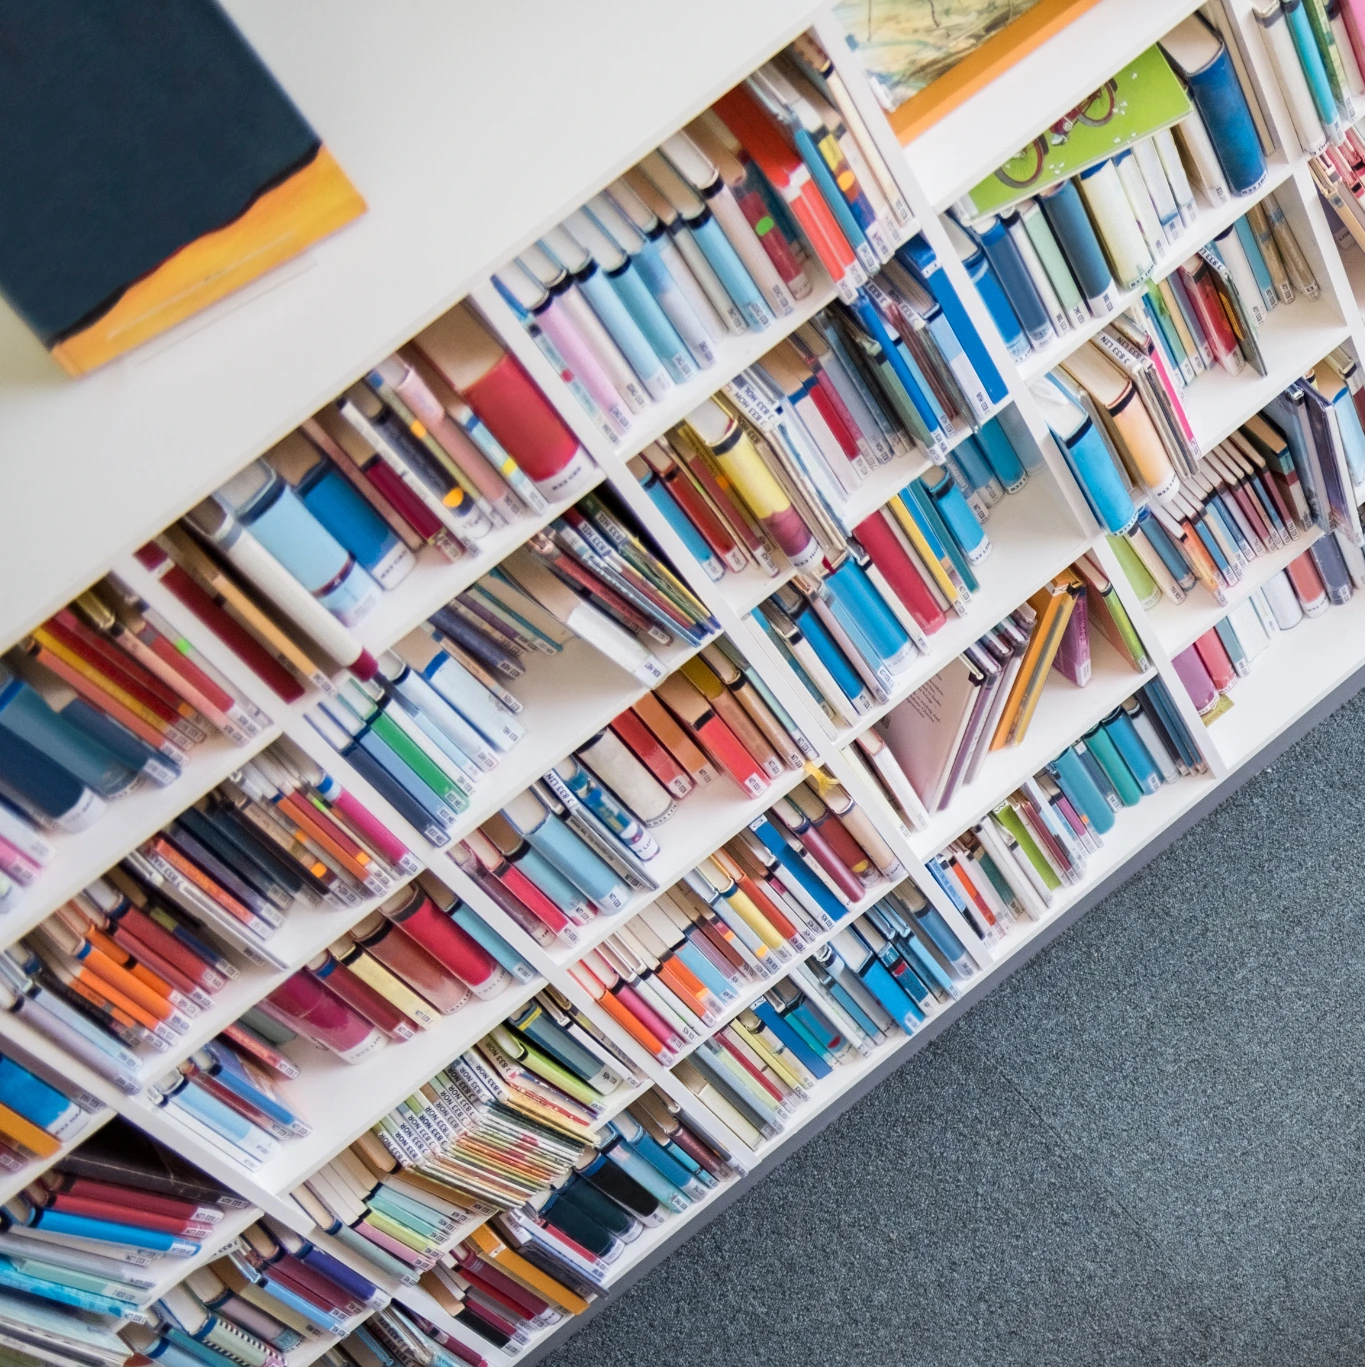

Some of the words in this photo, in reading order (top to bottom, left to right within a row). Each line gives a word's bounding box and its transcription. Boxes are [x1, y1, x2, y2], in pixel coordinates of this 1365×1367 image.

[886, 288, 904, 306] HUB
[900, 302, 916, 318] 833
[1100, 334, 1114, 348] LIN
[1116, 334, 1130, 349] LIN
[1110, 345, 1126, 360] 833
[1126, 345, 1142, 361] 833
[732, 390, 751, 409] HOH
[742, 385, 759, 403] HOL
[747, 406, 762, 422] 833
[755, 400, 770, 416] 833
[595, 512, 611, 528] HIL
[579, 522, 594, 538] HIL
[607, 524, 624, 541] 833
[590, 534, 607, 552] 833
[544, 772, 559, 787] LIN
[554, 783, 570, 800] 833
[162, 866, 179, 883] 833
[484, 1040, 499, 1056] NOR
[495, 1054, 508, 1068] 833
[447, 1066, 462, 1083] NOR
[459, 1066, 474, 1083] NOR
[475, 1063, 490, 1080] NOR
[447, 1084, 462, 1100] NOR
[458, 1080, 471, 1095] 833
[470, 1081, 483, 1095] 833
[486, 1077, 499, 1092] 833
[439, 1089, 454, 1106] NOR
[459, 1098, 472, 1113] 833
[425, 1105, 439, 1121] NOR
[435, 1100, 450, 1117] NOR
[451, 1104, 464, 1118] 833
[407, 1113, 422, 1130] NOR
[418, 1113, 434, 1129] NOR
[435, 1119, 448, 1133] 833
[446, 1114, 459, 1129] 833
[399, 1122, 415, 1138] NOR
[418, 1128, 432, 1142] 833
[430, 1127, 444, 1142] 833
[376, 1131, 393, 1149] NOR
[394, 1130, 408, 1147] NOR
[411, 1135, 425, 1150] 833
[389, 1145, 404, 1160] 833
[405, 1145, 417, 1159] 833
[376, 1317, 391, 1331] STE
[387, 1327, 401, 1341] 833
[395, 1348, 409, 1362] 833
